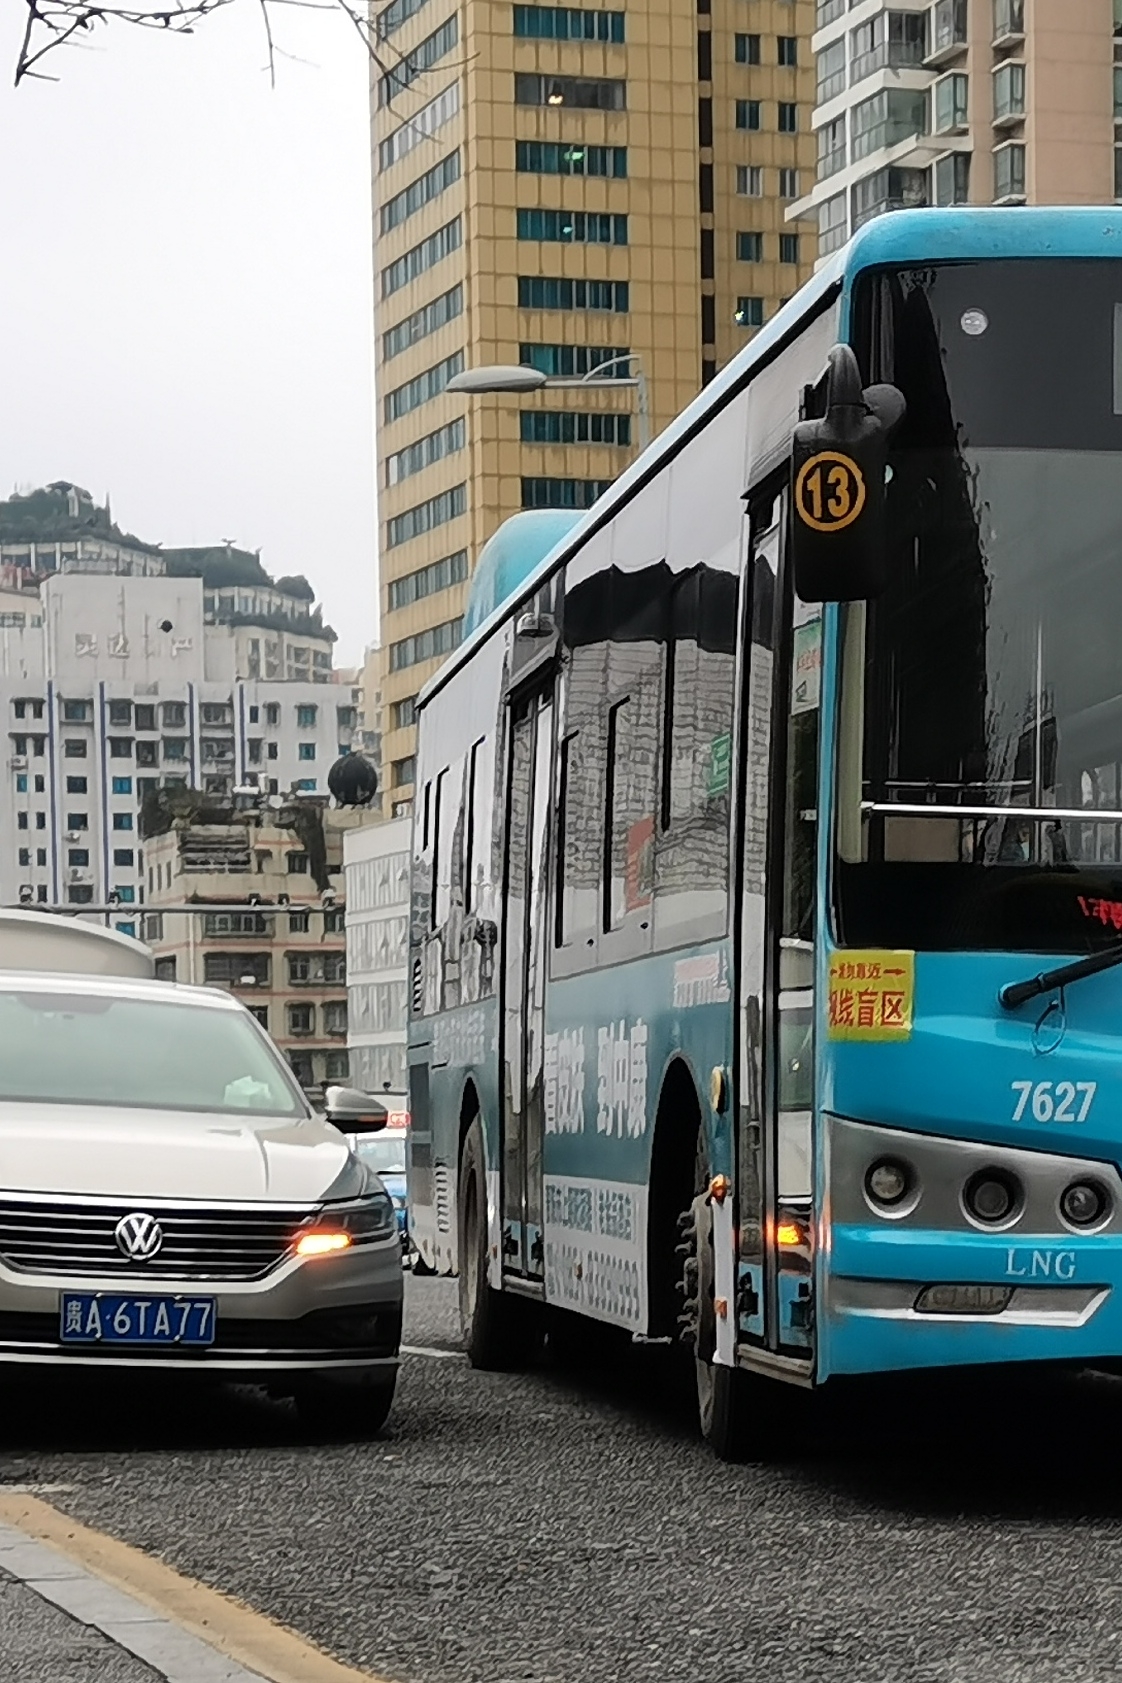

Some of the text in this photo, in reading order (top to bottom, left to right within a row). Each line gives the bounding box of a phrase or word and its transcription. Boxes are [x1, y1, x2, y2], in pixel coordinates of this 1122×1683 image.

[806, 466, 851, 519] 13
[1011, 1080, 1097, 1123] 7627
[1004, 1248, 1076, 1280] LNG
